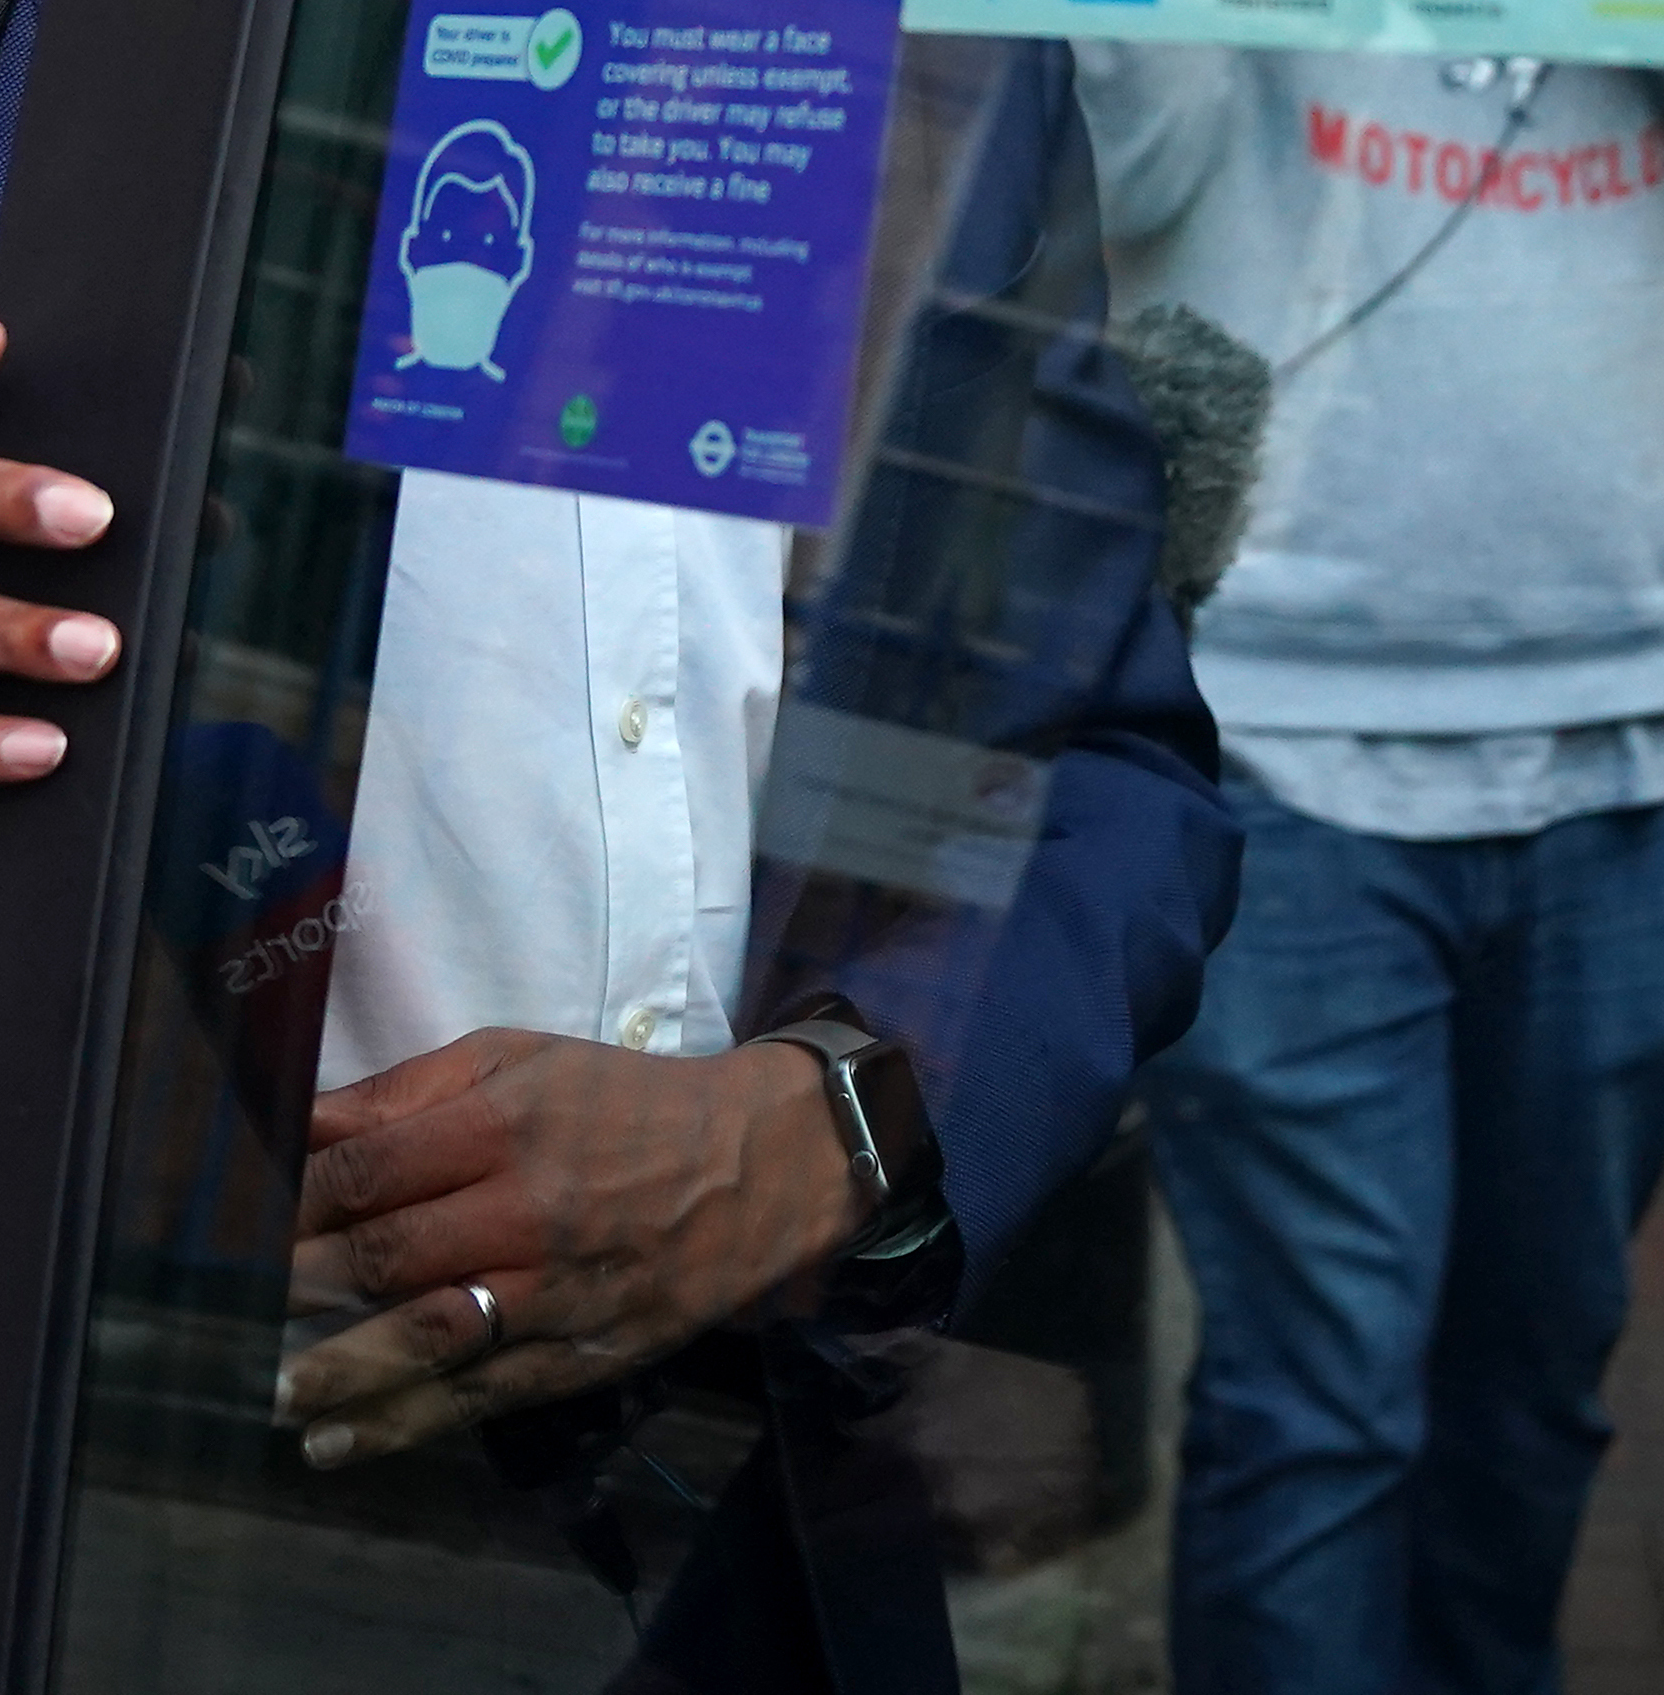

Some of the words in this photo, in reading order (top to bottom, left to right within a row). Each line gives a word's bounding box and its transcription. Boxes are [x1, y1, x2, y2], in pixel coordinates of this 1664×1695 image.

[609, 21, 650, 49] You
[650, 26, 704, 51] must
[708, 29, 762, 52] wear
[763, 30, 779, 53] a
[783, 24, 832, 54] face
[601, 59, 688, 93] covering
[690, 62, 759, 89] unless
[596, 97, 619, 119] or
[623, 96, 660, 122] the
[661, 96, 722, 124] driver
[724, 103, 772, 133] may
[774, 100, 846, 131] refuse
[592, 130, 617, 155] to
[619, 131, 665, 159] take
[719, 136, 761, 164] You
[762, 142, 813, 173] may
[587, 166, 629, 193] also
[631, 172, 707, 200] receive
[709, 177, 725, 200] a
[727, 171, 771, 204] fine
[578, 220, 603, 242] For
[606, 226, 645, 244] more
